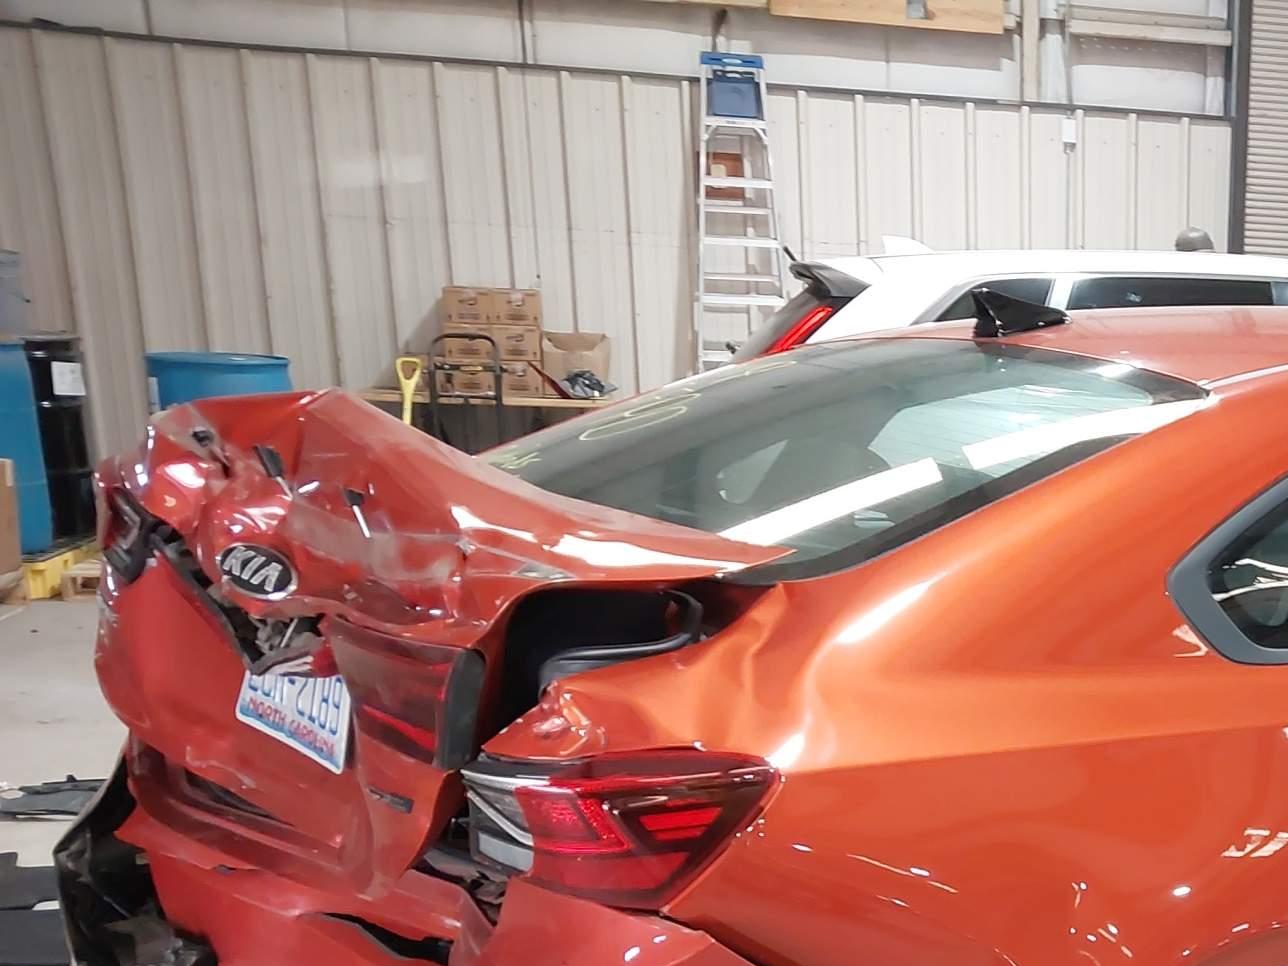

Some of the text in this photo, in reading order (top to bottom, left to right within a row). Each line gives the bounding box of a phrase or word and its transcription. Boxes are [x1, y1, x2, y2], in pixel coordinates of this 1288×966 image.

[222, 546, 283, 592] KIA
[247, 696, 336, 757] NORTH CAROLINA
